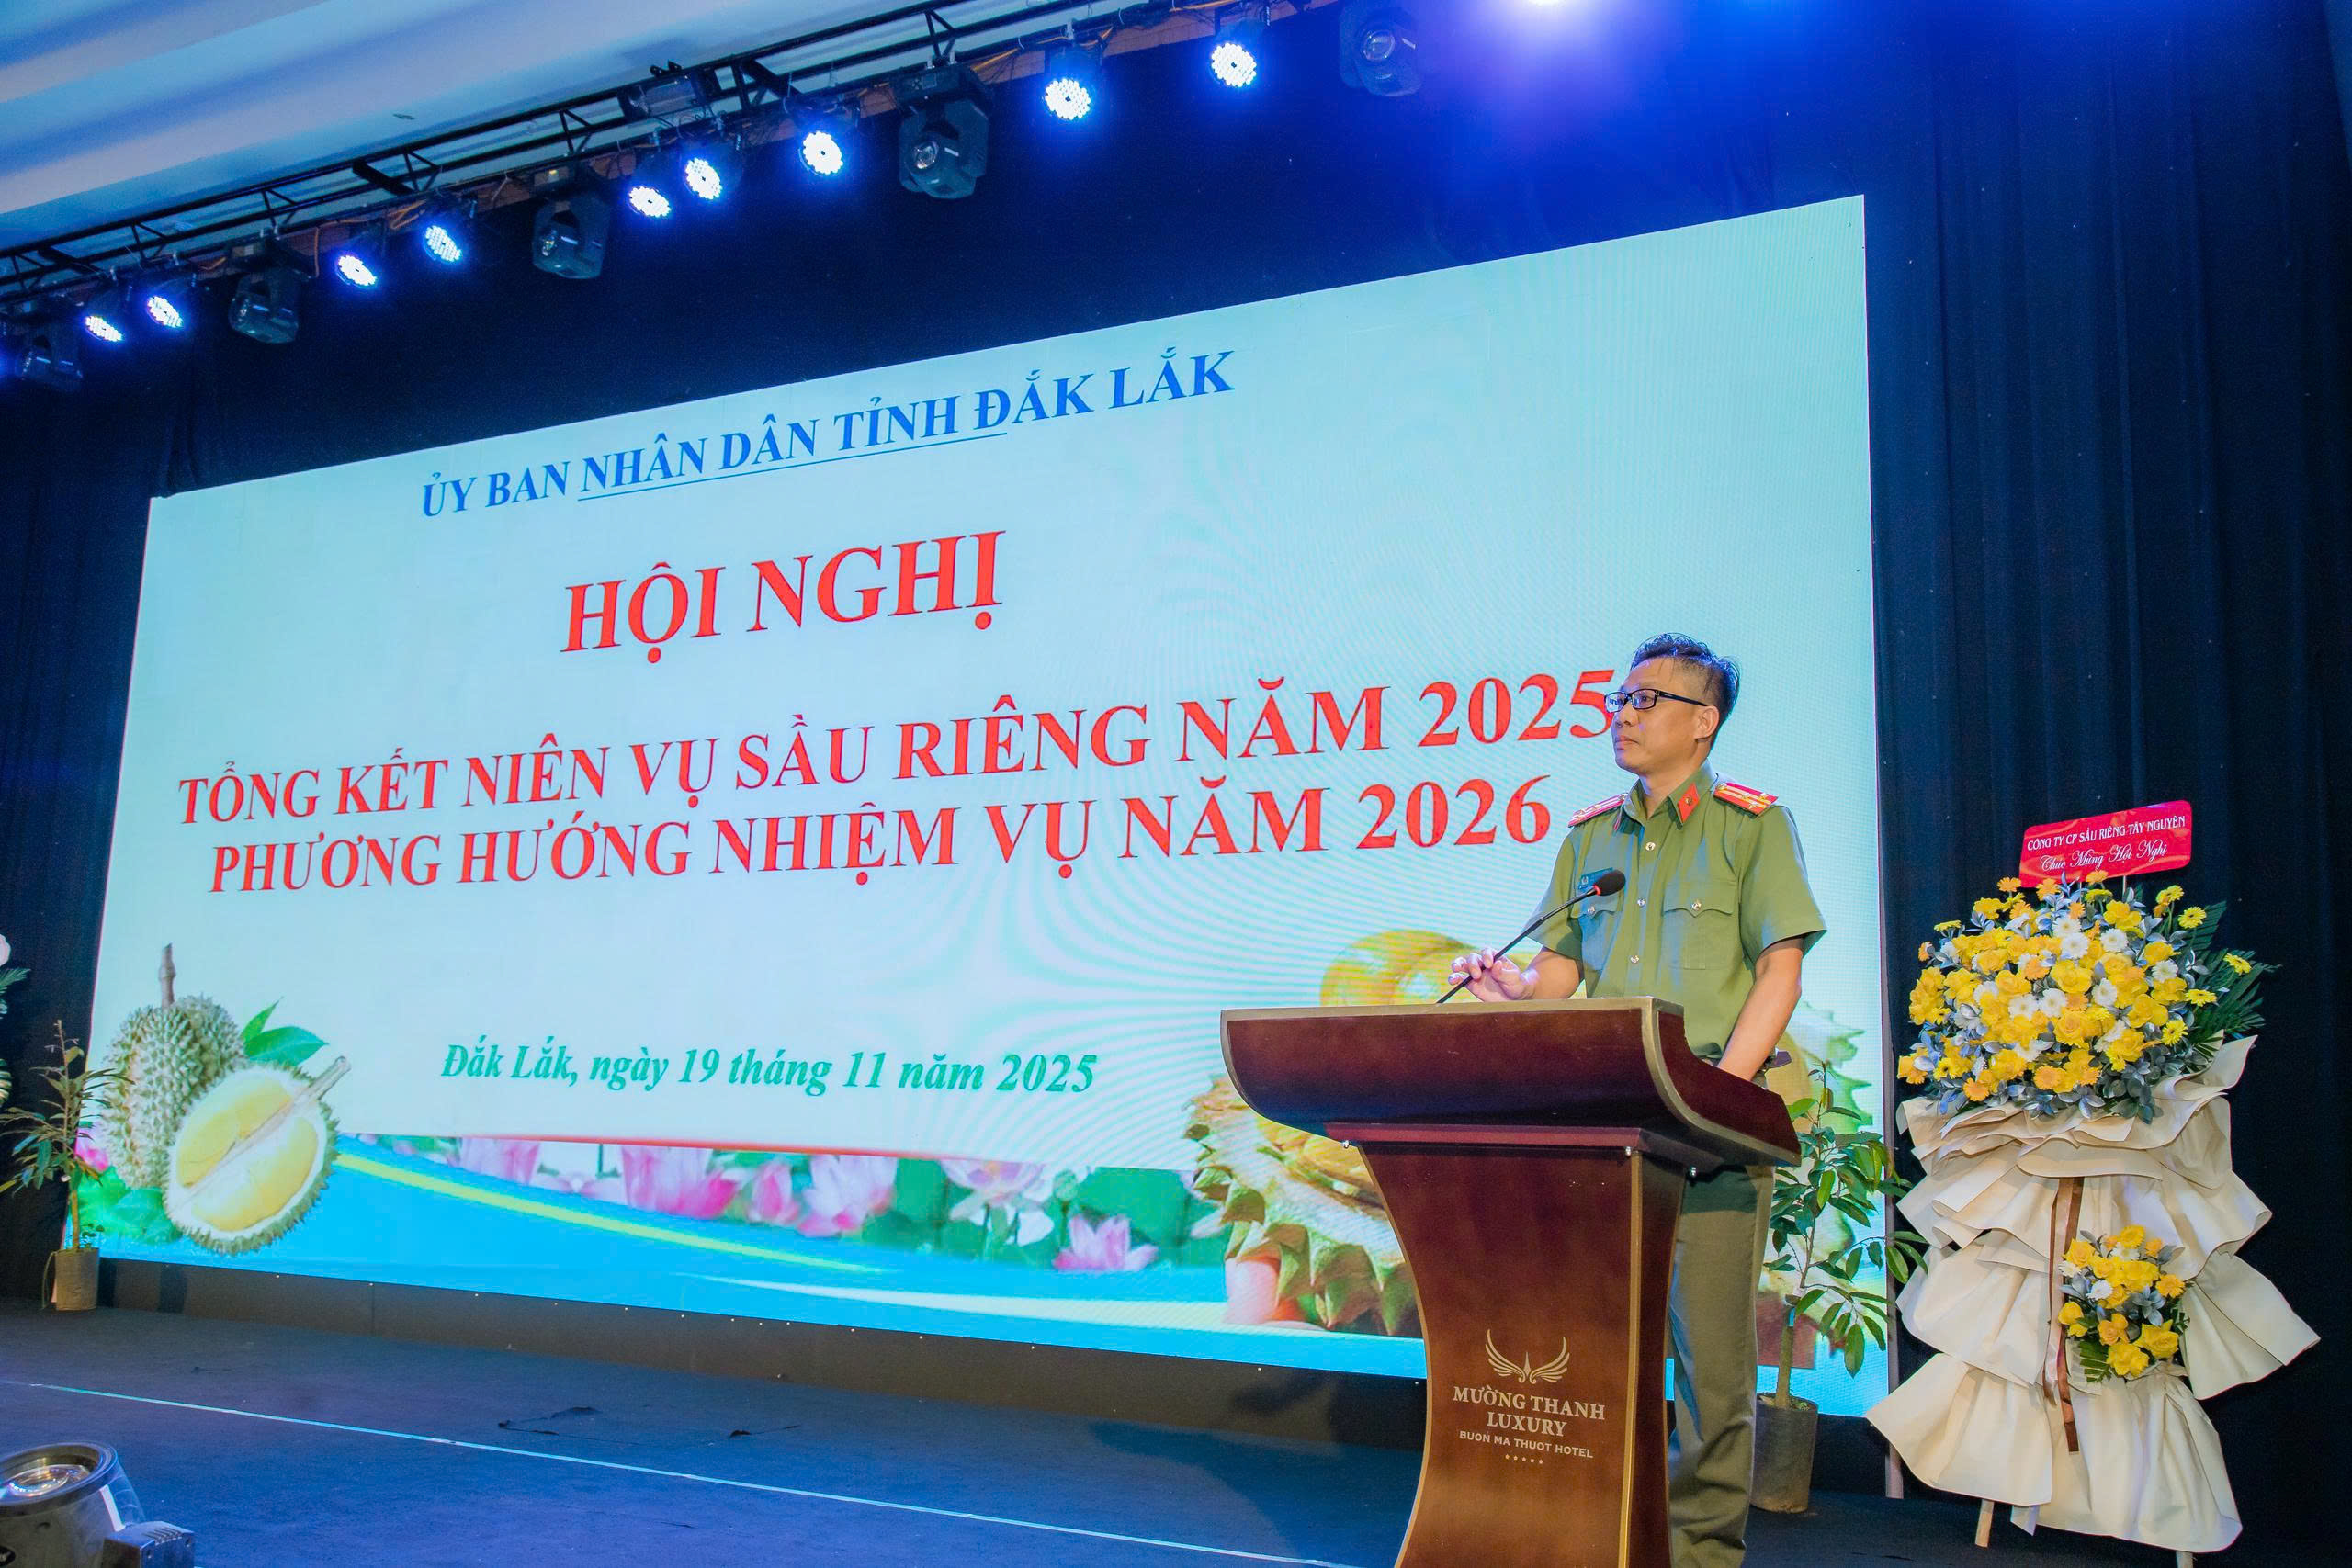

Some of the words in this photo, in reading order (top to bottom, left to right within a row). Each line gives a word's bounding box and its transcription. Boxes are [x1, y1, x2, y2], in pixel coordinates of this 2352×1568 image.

[424, 471, 478, 516] ỦY
[486, 460, 570, 507] BAN
[578, 432, 709, 492] NHÂN
[719, 413, 821, 469] DÂN
[833, 396, 961, 451] TỈNH
[973, 369, 1095, 430] ĐẮK
[1108, 346, 1236, 410] LẮK
[560, 561, 726, 664] HỘI
[748, 529, 1006, 631] NGHỊ
[178, 761, 320, 824] TỔNG
[335, 747, 448, 815] KẾT
[461, 732, 608, 807] NIÊN
[628, 737, 721, 808] VỤ
[736, 714, 876, 790] SẦU
[896, 694, 1149, 779] RIÊNG
[1177, 677, 1392, 763] NĂM
[1418, 669, 1615, 748] 2025
[209, 831, 441, 893] PHƯƠNG
[458, 810, 692, 883] HƯỚNG
[708, 801, 962, 886] NHIỆM
[983, 798, 1097, 880] VỤ
[1118, 773, 1329, 859] NĂM
[1357, 774, 1553, 850] 2026
[2027, 838, 2052, 851] CÔNG
[2054, 835, 2064, 847] TY
[2065, 833, 2078, 845] CP
[2098, 825, 2126, 840] RIÊNG
[2128, 821, 2144, 834] TÂY
[2146, 815, 2186, 832] NGUYÊN
[2136, 839, 2167, 863] Nghị
[440, 1033, 506, 1079] Đắk
[510, 1035, 579, 1089] Lắk,
[589, 1045, 670, 1092] ngày
[677, 1048, 721, 1085] 19
[728, 1047, 833, 1098] tháng
[842, 1051, 888, 1089] 11
[897, 1053, 986, 1093] năm
[995, 1052, 1102, 1095] 2025
[1453, 1384, 1526, 1410] MƯỜNG
[1530, 1395, 1605, 1420] THANH
[1487, 1411, 1567, 1437] LUXURY
[1459, 1430, 1491, 1443] BUON
[1494, 1435, 1510, 1447] MA
[1513, 1438, 1553, 1452] THUOT
[1555, 1444, 1594, 1459] HOTEL
